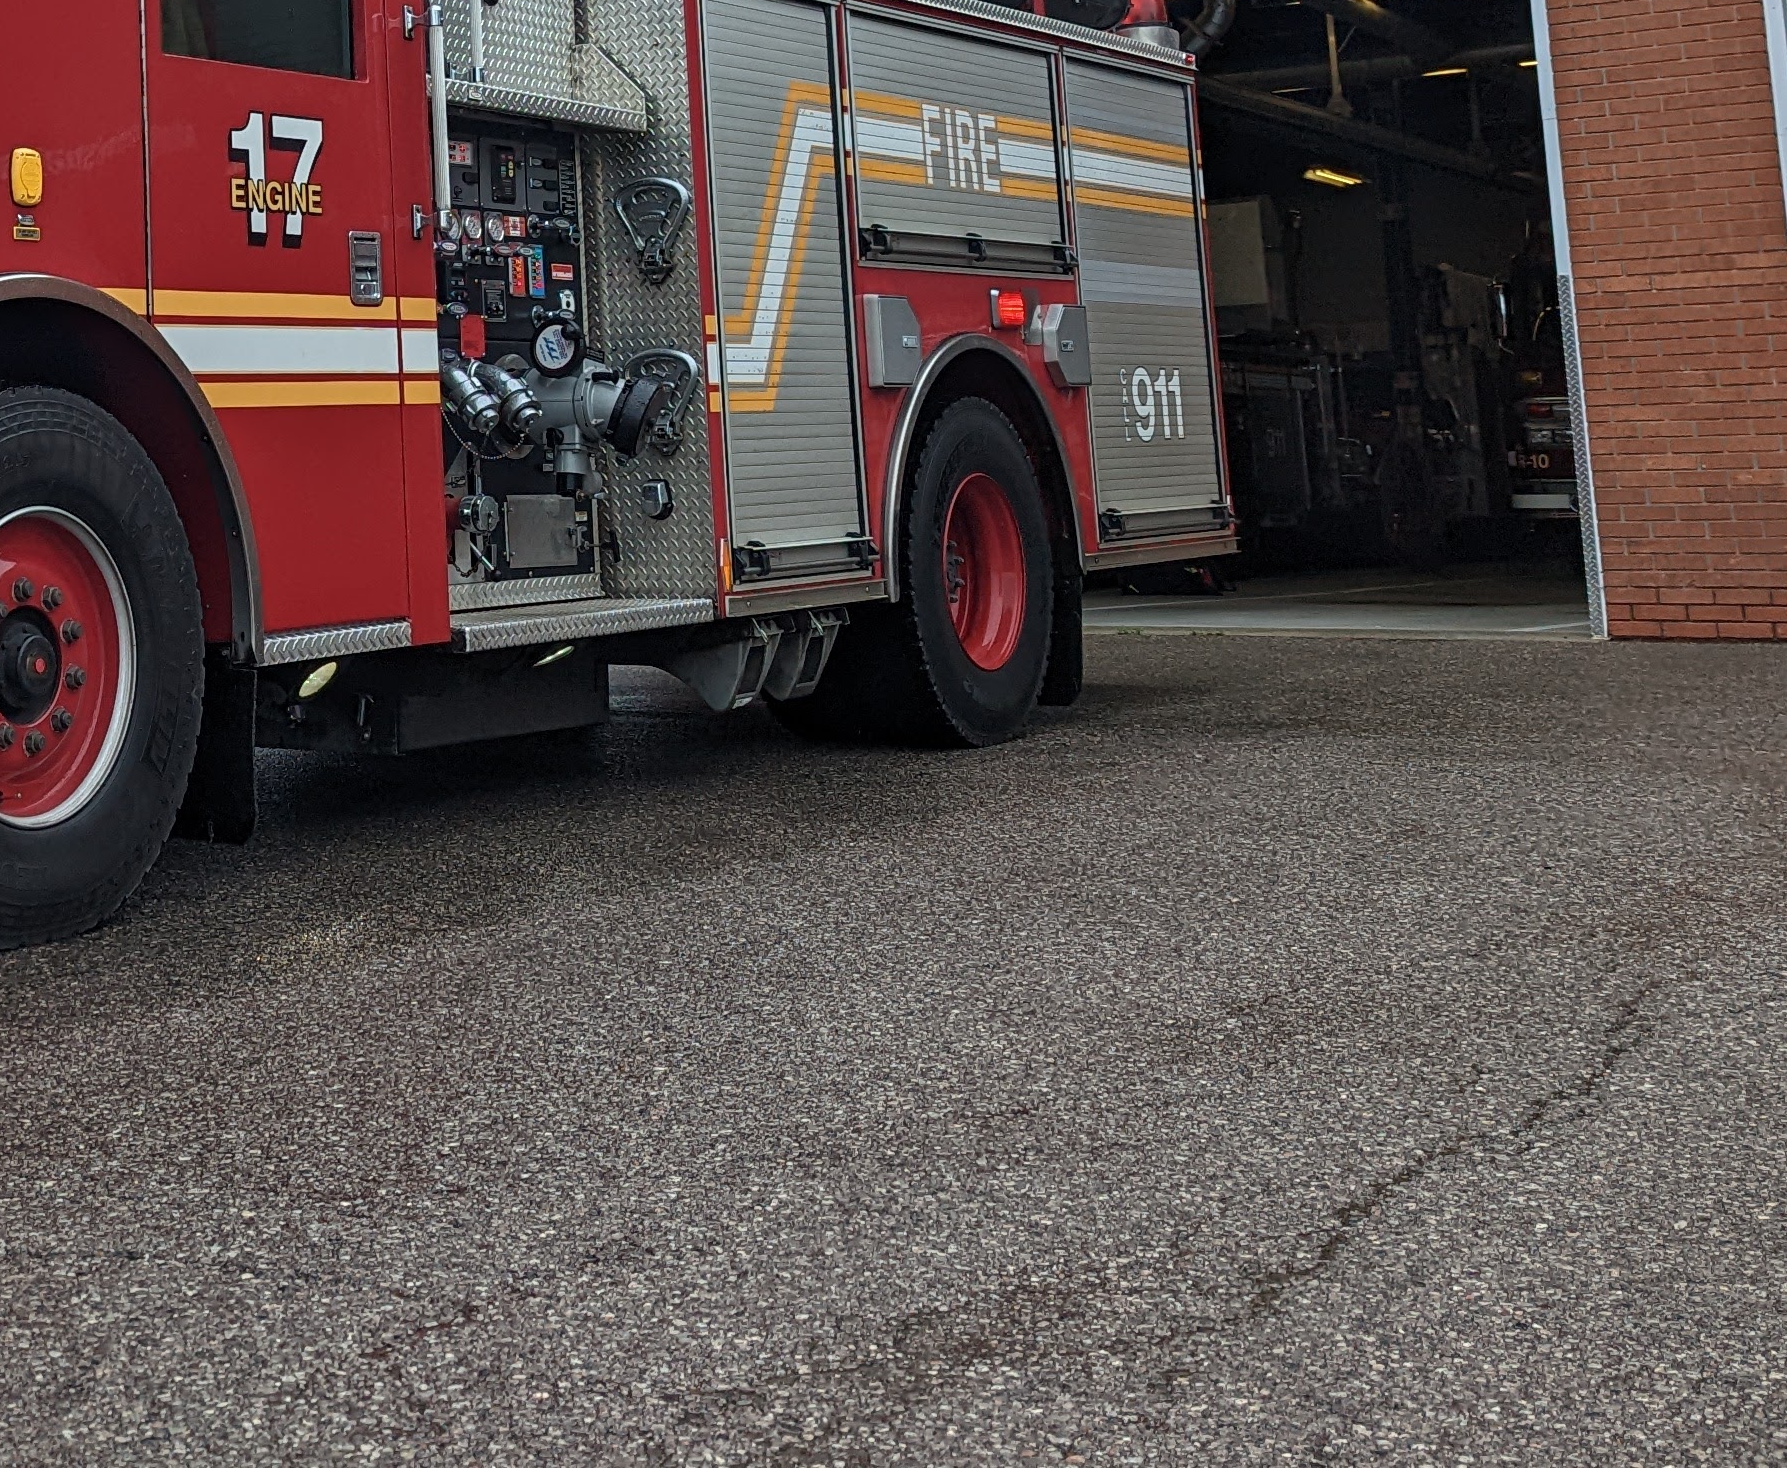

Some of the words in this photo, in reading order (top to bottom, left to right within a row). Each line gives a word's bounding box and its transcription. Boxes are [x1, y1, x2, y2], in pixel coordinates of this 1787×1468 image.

[229, 111, 323, 245] 17
[921, 103, 1001, 193] FIRE
[230, 177, 324, 215] ENGINE
[1119, 368, 1132, 442] CALL
[1131, 365, 1186, 443] 911
